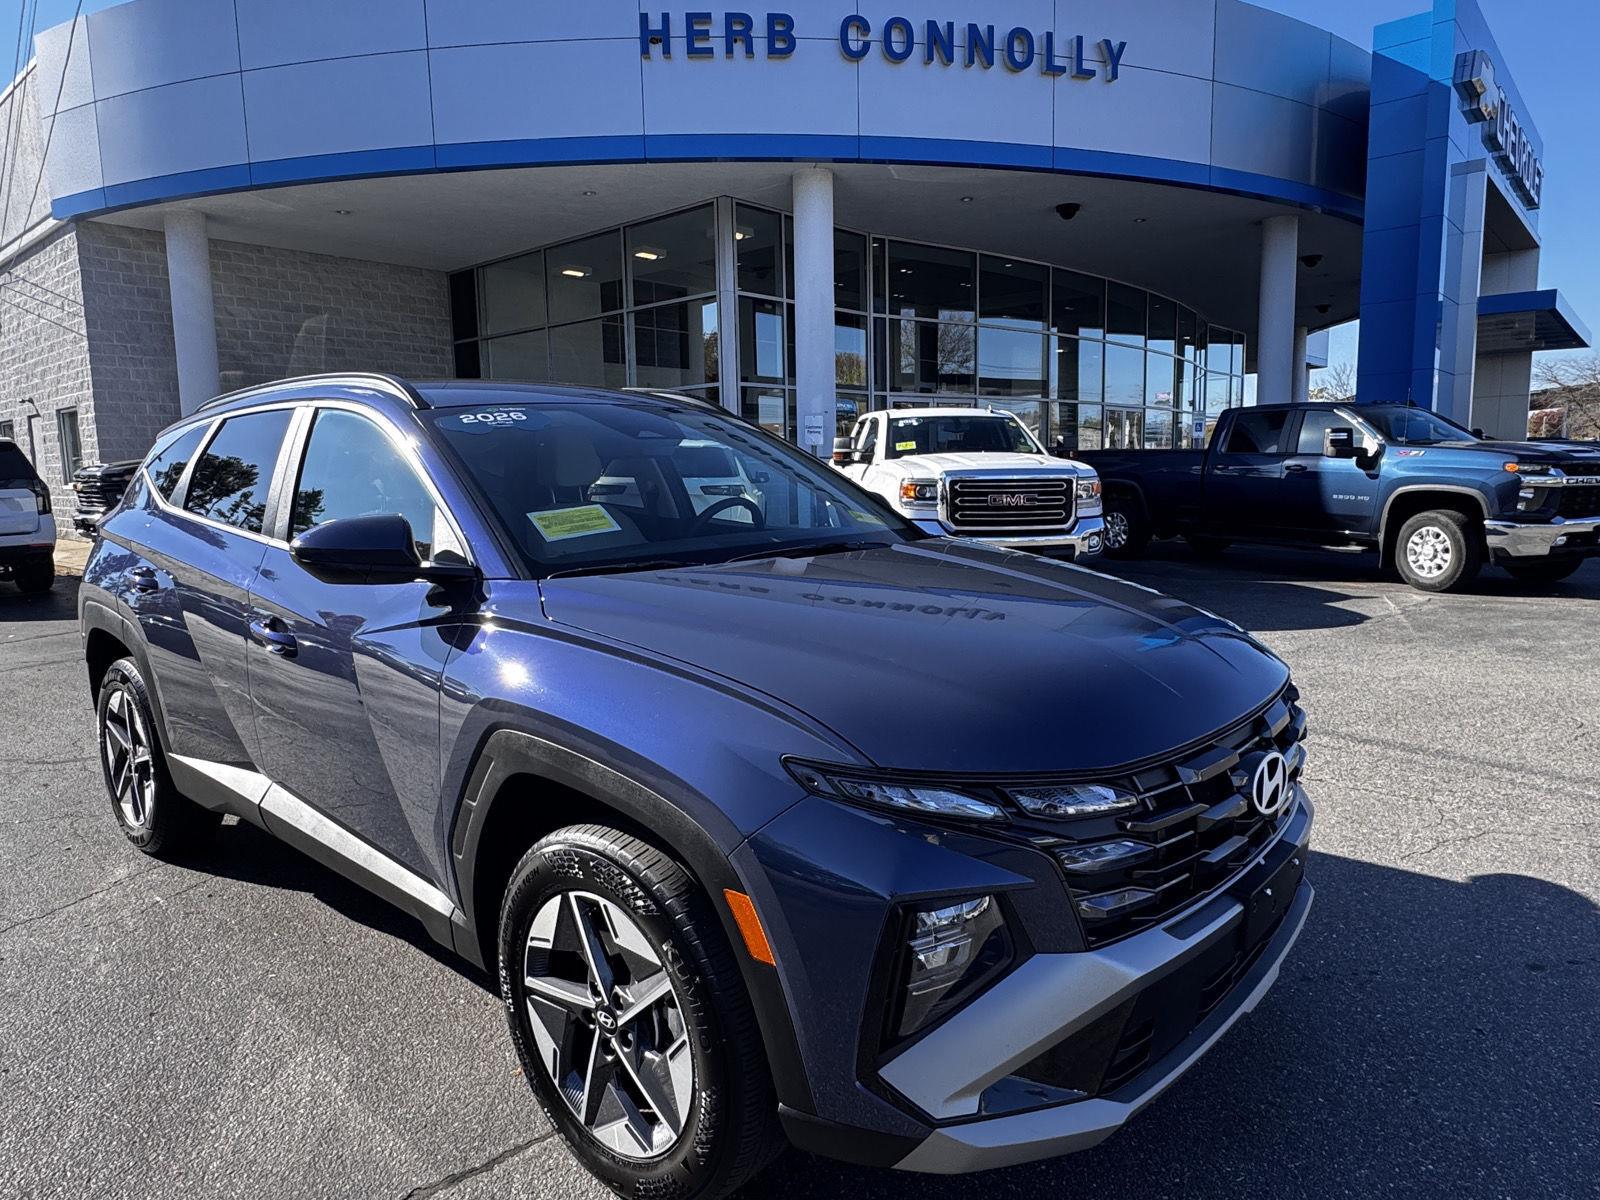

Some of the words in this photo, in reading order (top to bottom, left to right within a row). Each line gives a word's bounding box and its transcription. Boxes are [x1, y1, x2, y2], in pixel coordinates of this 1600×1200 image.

[639, 12, 797, 59] HERB
[838, 14, 1128, 82] CONNOLLY
[459, 412, 527, 424] 2026
[987, 493, 1038, 506] GMC
